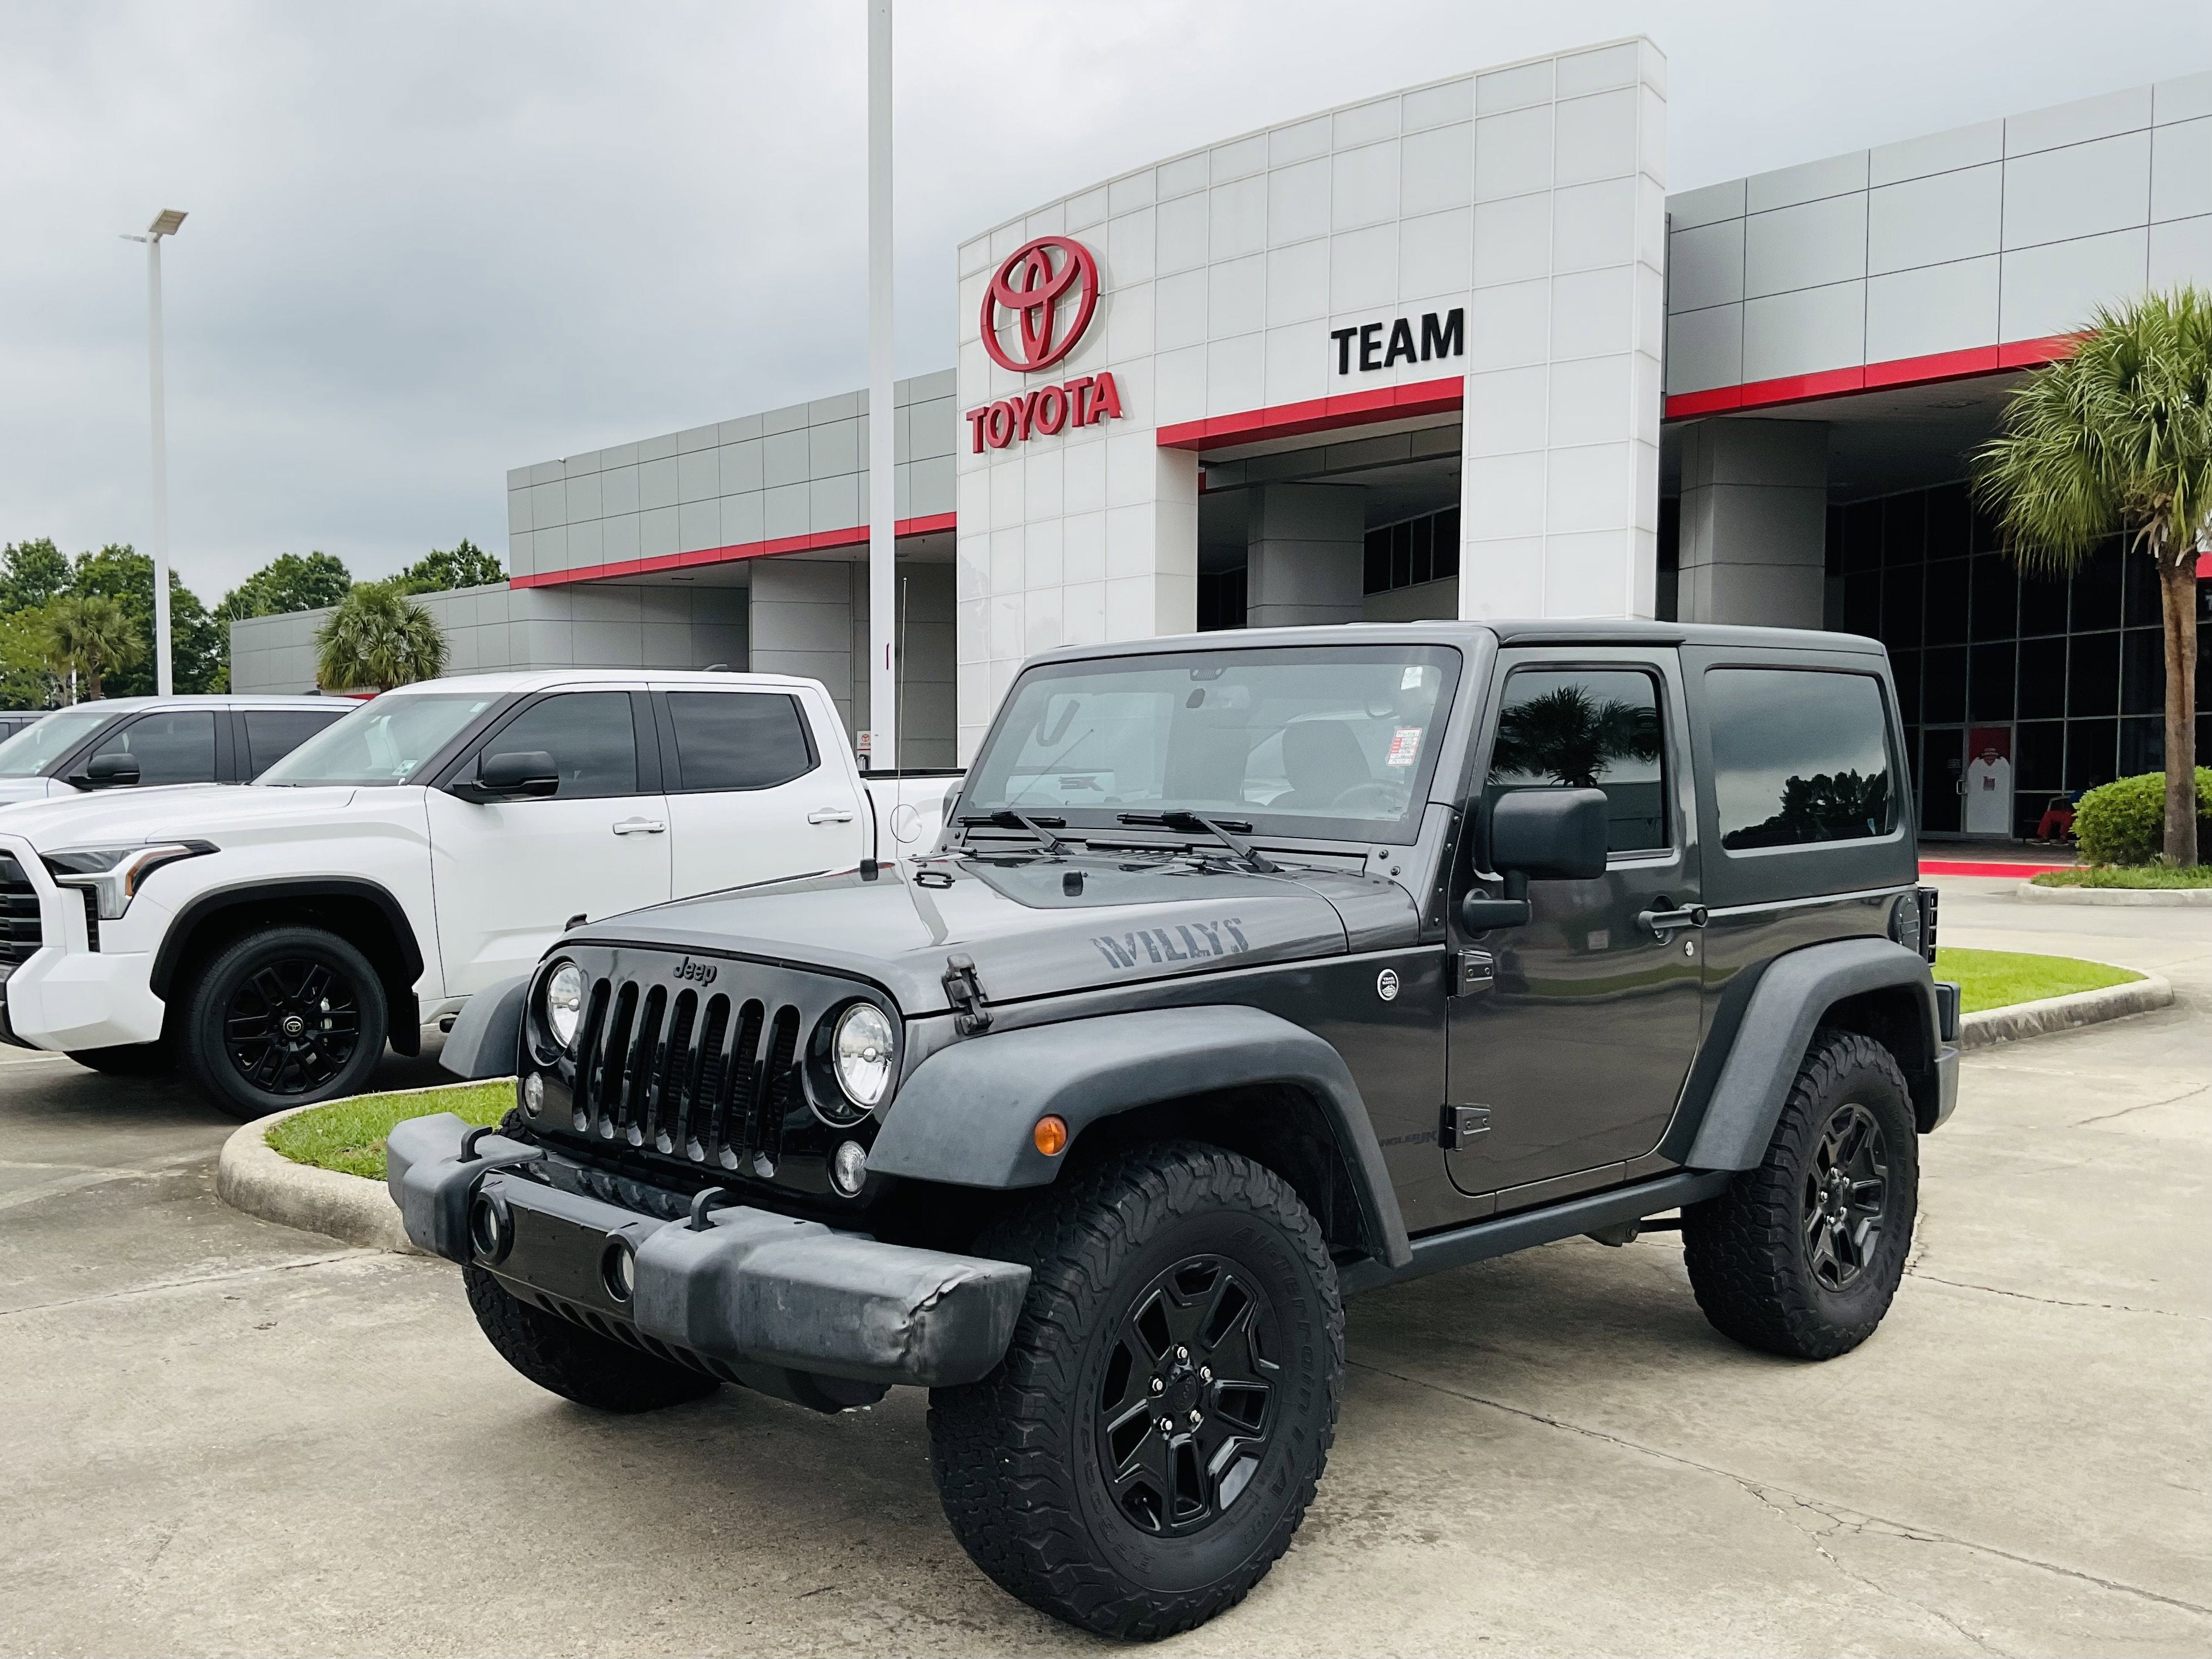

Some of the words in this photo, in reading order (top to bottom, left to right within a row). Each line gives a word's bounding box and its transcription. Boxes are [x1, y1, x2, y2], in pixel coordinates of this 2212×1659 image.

[1331, 307, 1464, 374] TEAM
[966, 371, 1123, 454] TOYOTA
[673, 956, 717, 987] Jeep
[1090, 918, 1249, 969] WILLYS
